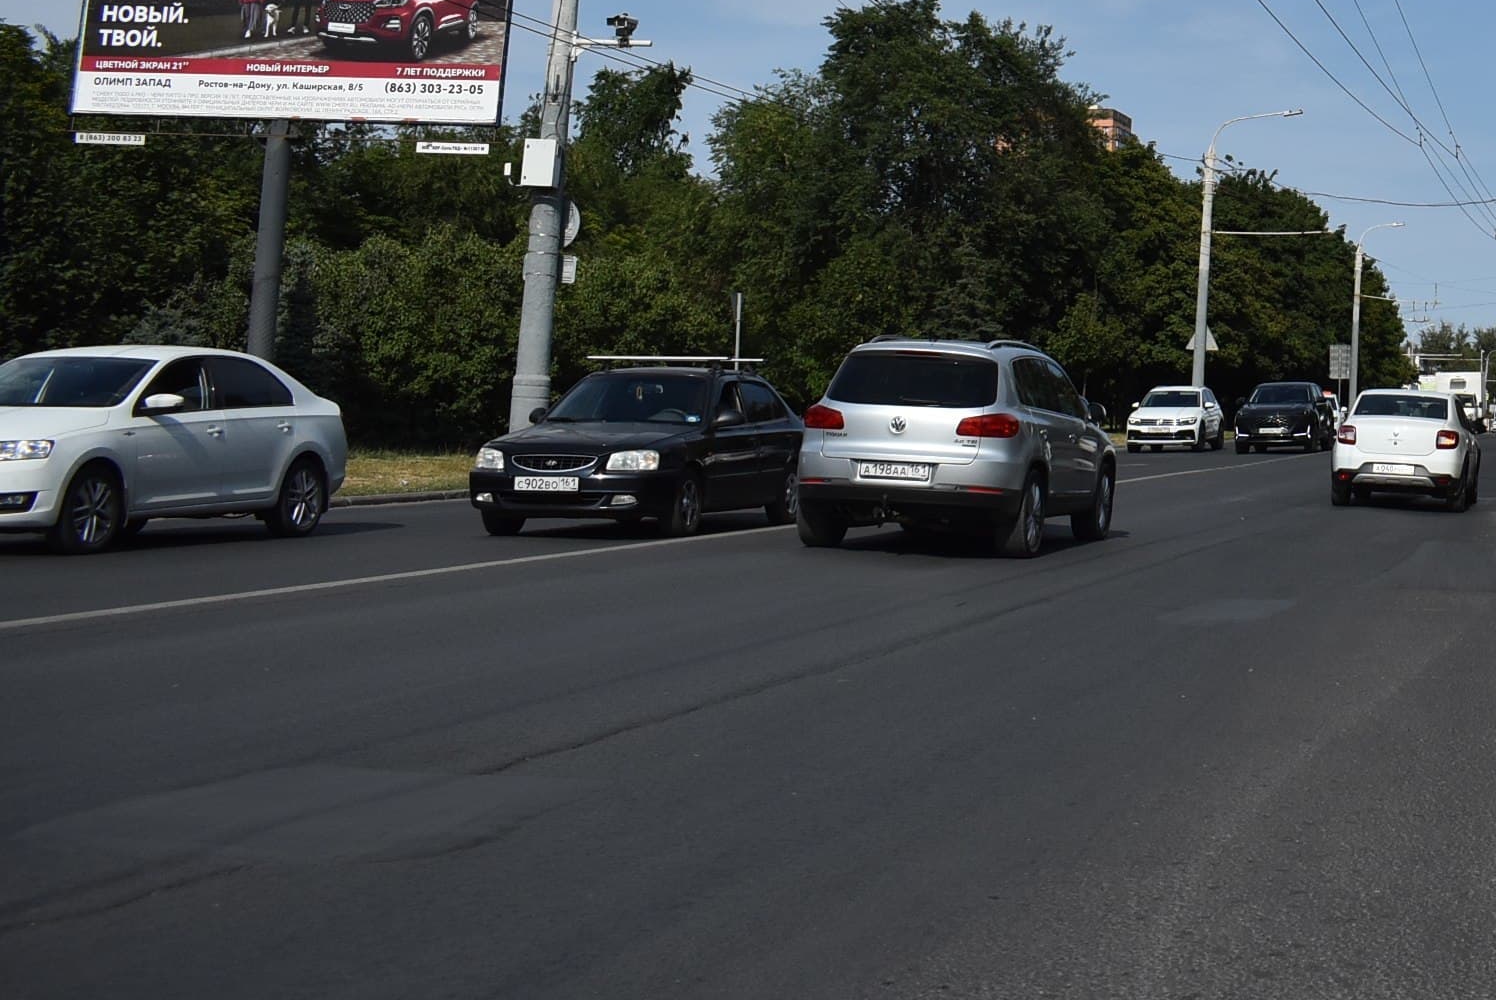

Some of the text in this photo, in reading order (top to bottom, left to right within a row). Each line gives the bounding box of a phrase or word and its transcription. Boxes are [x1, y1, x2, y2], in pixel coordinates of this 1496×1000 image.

[101, 3, 189, 24] НОВЫЙ.
[99, 26, 163, 48] ТВОЙ.
[95, 59, 139, 70] ЦВЕТНОЙ
[139, 60, 171, 71] ЭКРАН
[246, 63, 330, 74] НОВЫЙ ИНТЕРЬЕР
[396, 67, 486, 78] 7 ЛЕТ ПОДДЕРЖКИ
[93, 76, 172, 89] ОЛИМП ЗАПАД
[198, 79, 364, 93] Ростов-на-Дону, ул. Каширская, 8/5
[384, 81, 484, 95] (863) 303-23-05
[864, 463, 927, 476] А198АА 161
[517, 477, 577, 490] С902ВО 161
